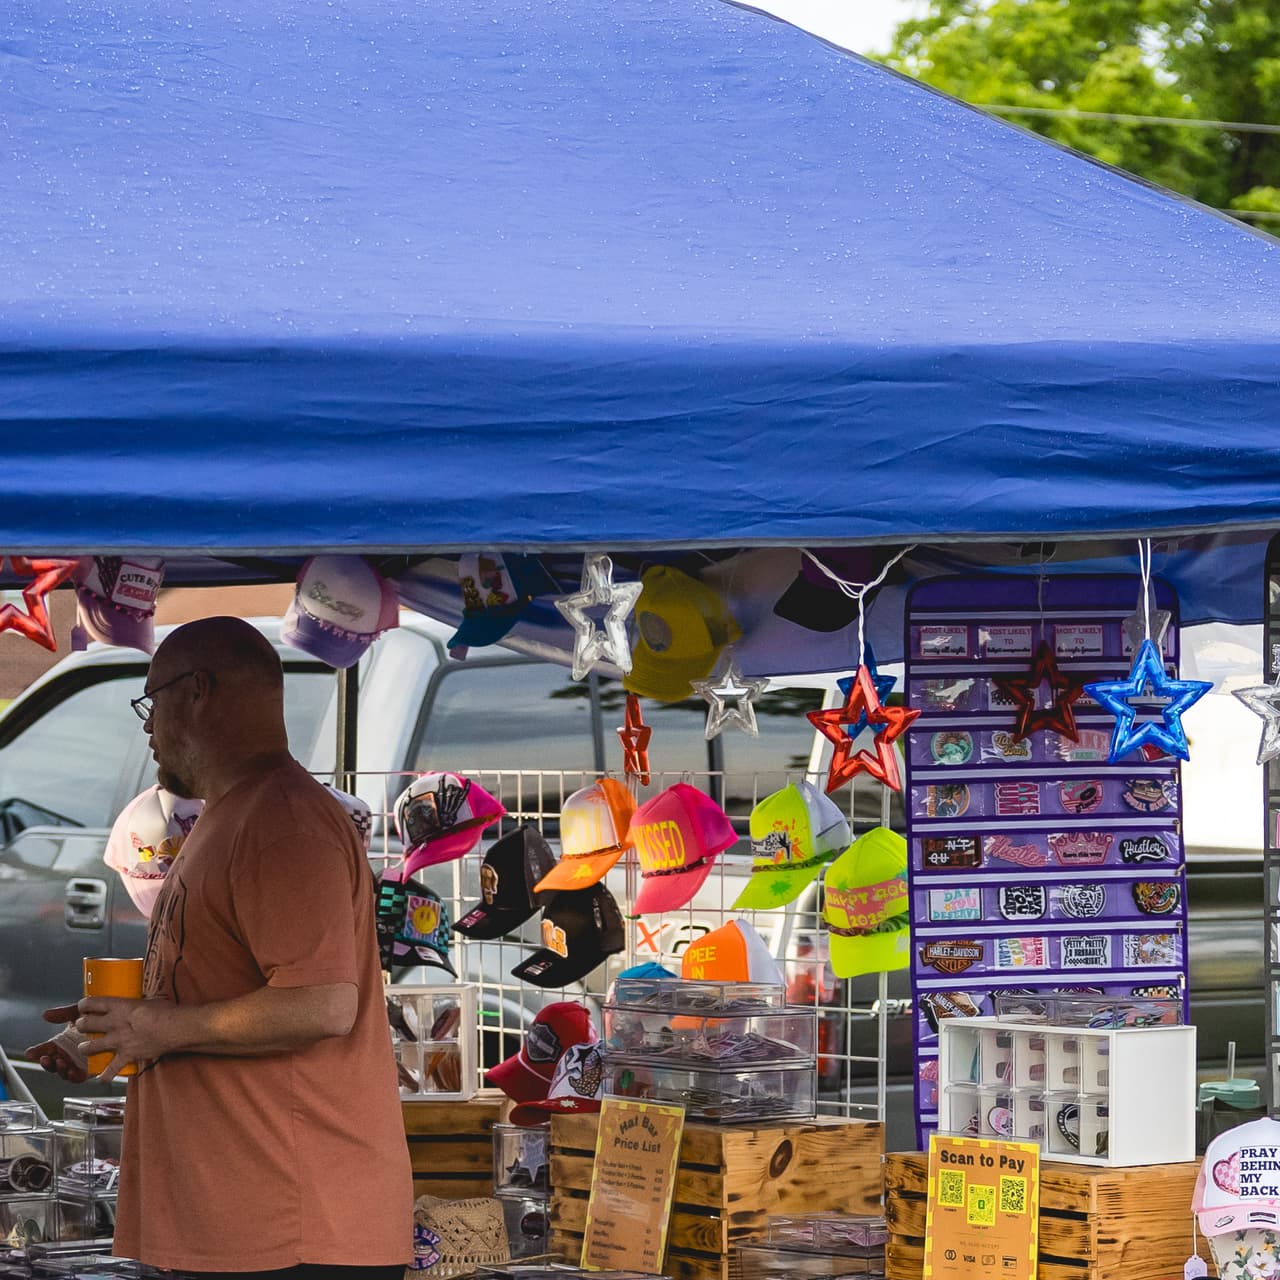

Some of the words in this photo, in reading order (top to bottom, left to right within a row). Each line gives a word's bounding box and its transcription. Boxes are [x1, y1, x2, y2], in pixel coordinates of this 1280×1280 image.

[933, 908, 980, 920] DESERVE
[689, 945, 717, 963] PEE
[690, 965, 705, 980] IN
[620, 1115, 639, 1135] Hat
[641, 1115, 659, 1138] Bar
[614, 1137, 639, 1150] Price
[642, 1141, 661, 1153] List
[1239, 1147, 1278, 1159] PRAY
[940, 1149, 975, 1166] Scan
[979, 1153, 995, 1168] to
[999, 1155, 1025, 1173] Pay
[1239, 1173, 1262, 1184] MY
[1239, 1185, 1280, 1196] BACK
[963, 1254, 977, 1264] VISA
